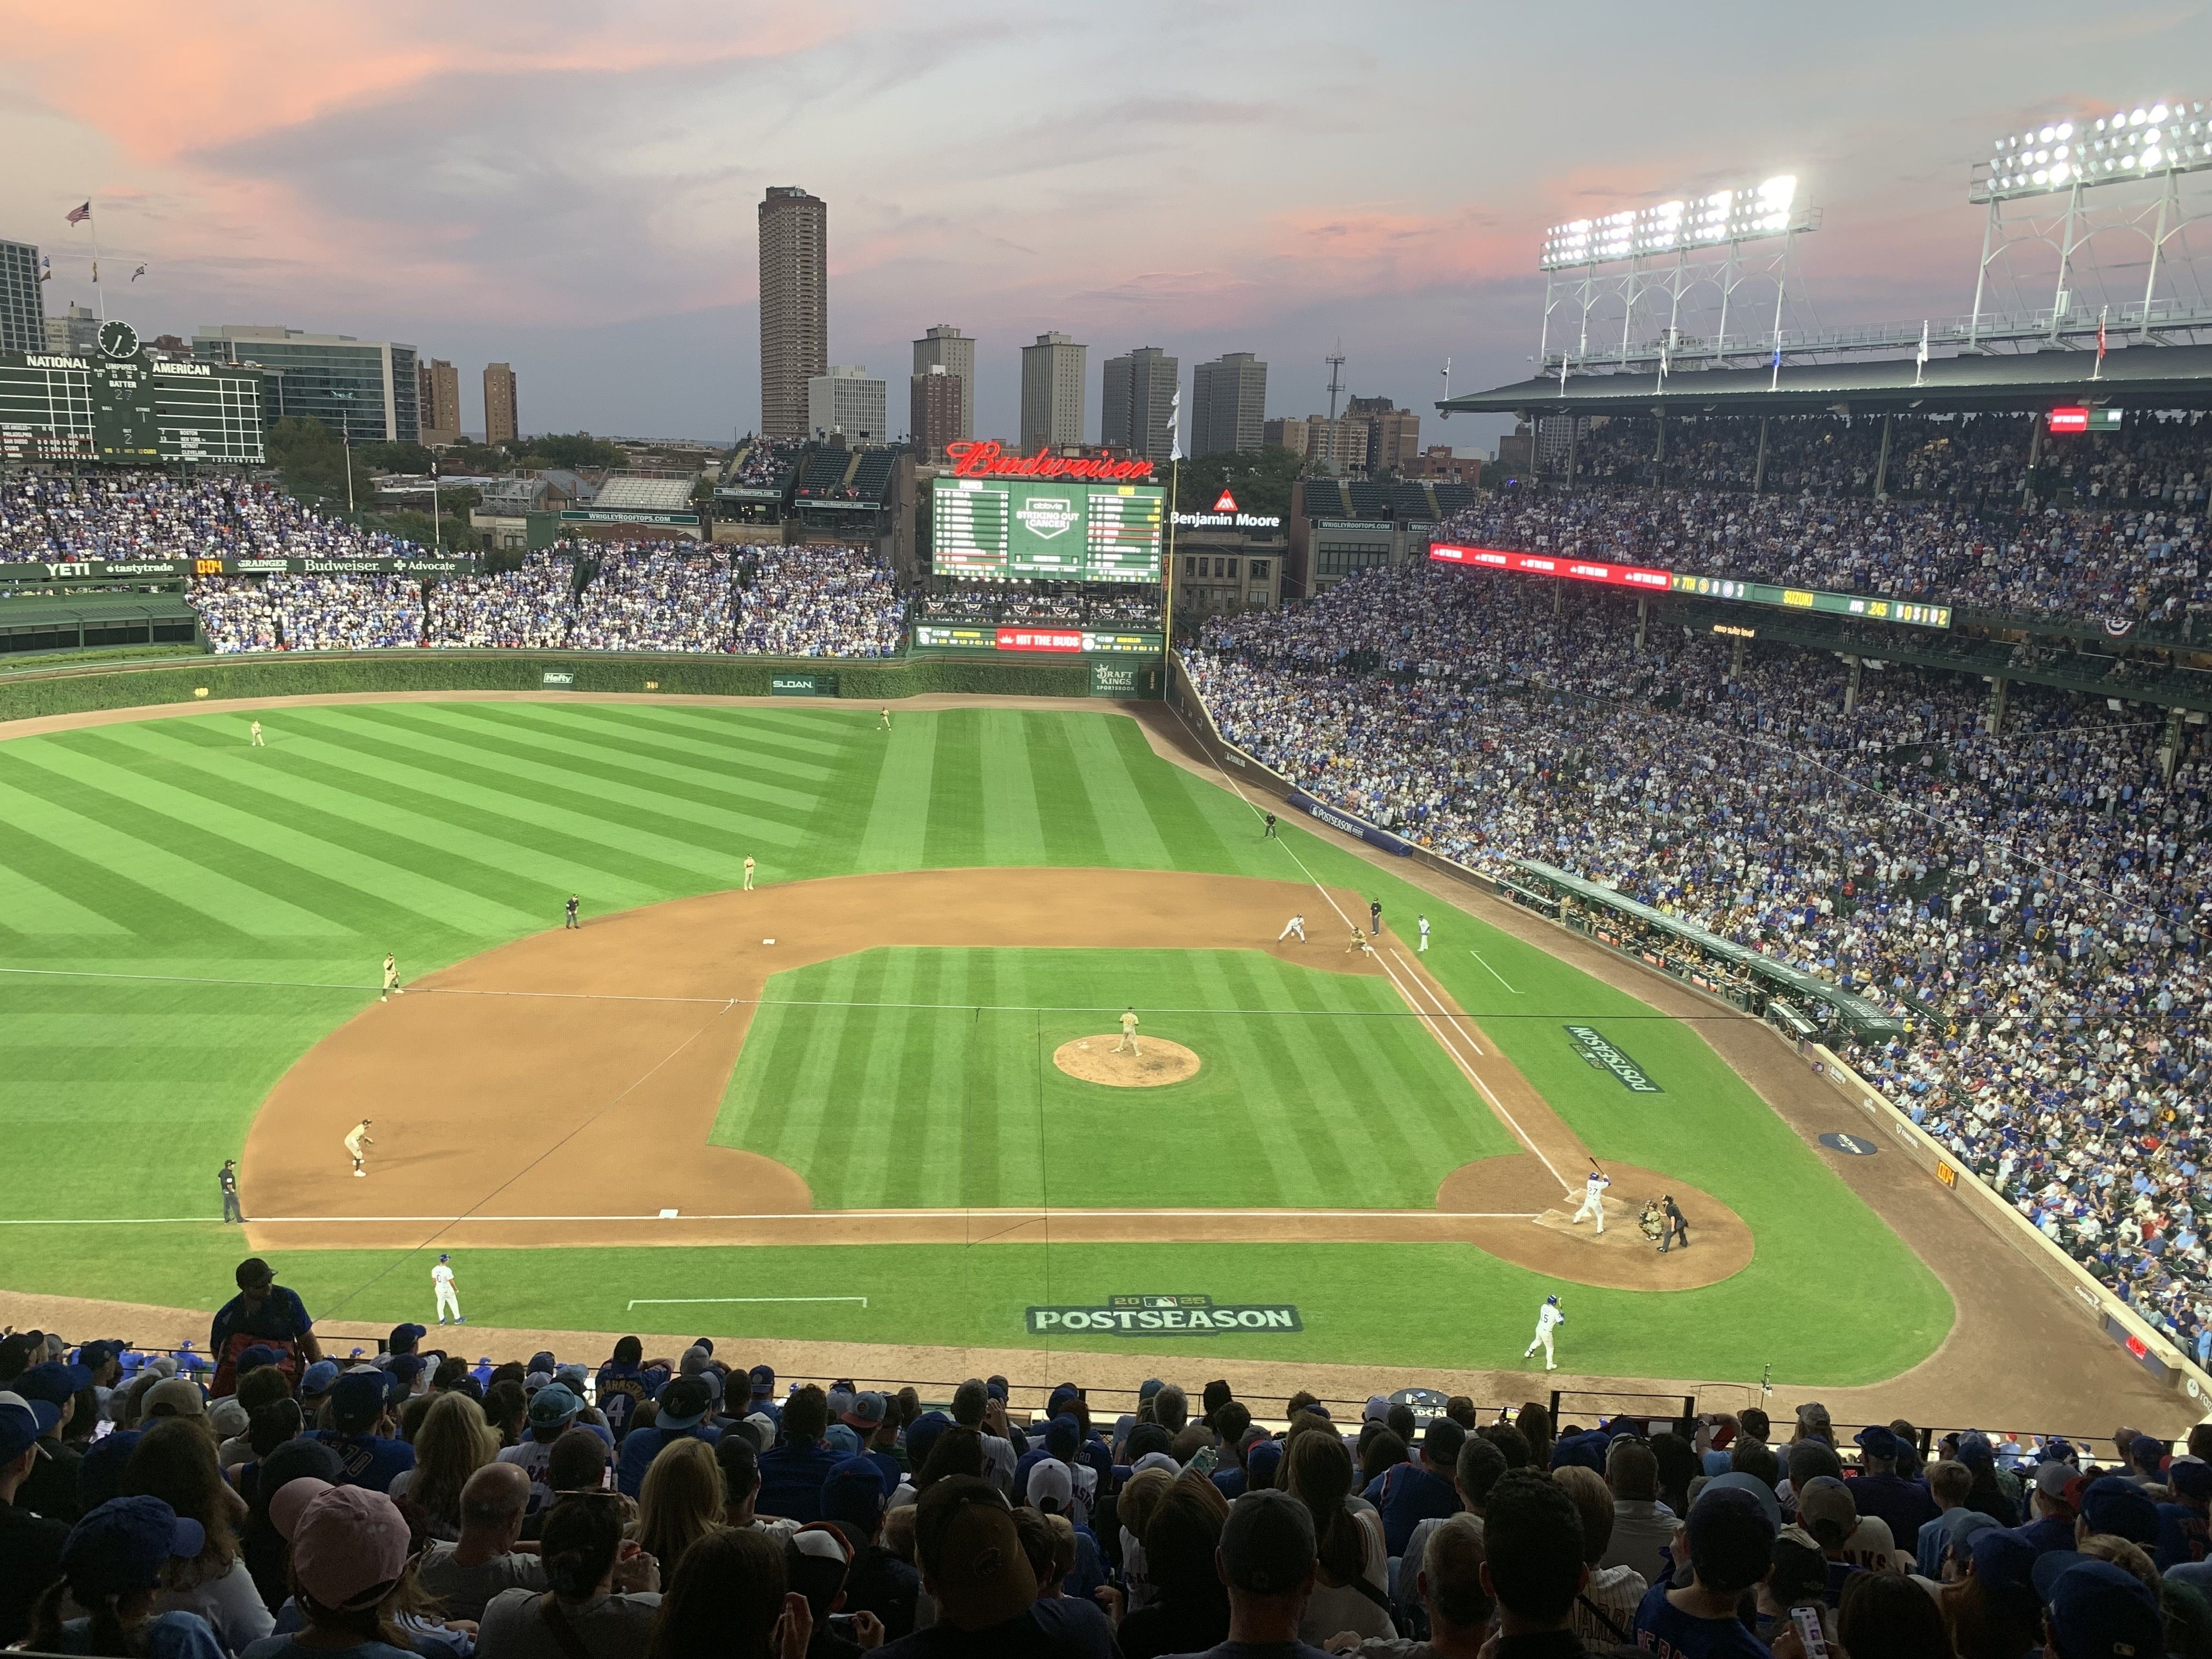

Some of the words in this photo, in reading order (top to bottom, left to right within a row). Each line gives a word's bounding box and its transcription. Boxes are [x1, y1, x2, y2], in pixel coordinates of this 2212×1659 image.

[27, 356, 90, 369] NATIONAL
[153, 362, 210, 375] AMERICAN
[109, 380, 137, 388] BATTER
[125, 434, 133, 444] 2
[947, 441, 1153, 478] Budweiser
[1033, 502, 1063, 510] abbvie
[1016, 511, 1060, 520] STRIKING
[1060, 512, 1080, 521] OUT
[1171, 512, 1232, 527] Benjamin
[1236, 514, 1280, 527] Moore
[1029, 519, 1065, 527] CANCER
[45, 563, 90, 576] YETI
[115, 563, 174, 574] tastytrade
[196, 560, 222, 573] 0:04
[238, 560, 287, 568] GRAINGER
[304, 560, 379, 571] Budweiser
[409, 561, 455, 570] Advocate
[1682, 577, 1696, 590] 7TH
[1713, 581, 1719, 594] 0
[1737, 584, 1744, 597] 3
[1784, 590, 1814, 607] SUZUKI
[1849, 600, 1864, 613] AVG
[1868, 601, 1887, 617] .245
[1913, 607, 1921, 620] S
[1938, 610, 1948, 625] 2
[1728, 626, 1740, 635] suite
[1741, 627, 1754, 637] level
[1017, 634, 1032, 645] HIT
[1034, 635, 1052, 646] THE
[1053, 636, 1079, 647] BUDS
[1097, 670, 1133, 679] DRAFT
[1318, 809, 1353, 833] POSTSEASON
[1570, 1027, 1656, 1091] POSTSEASON
[1589, 1187, 1598, 1195] 27
[1035, 1311, 1294, 1329] POSTSEASON
[606, 1394, 625, 1426] 4
